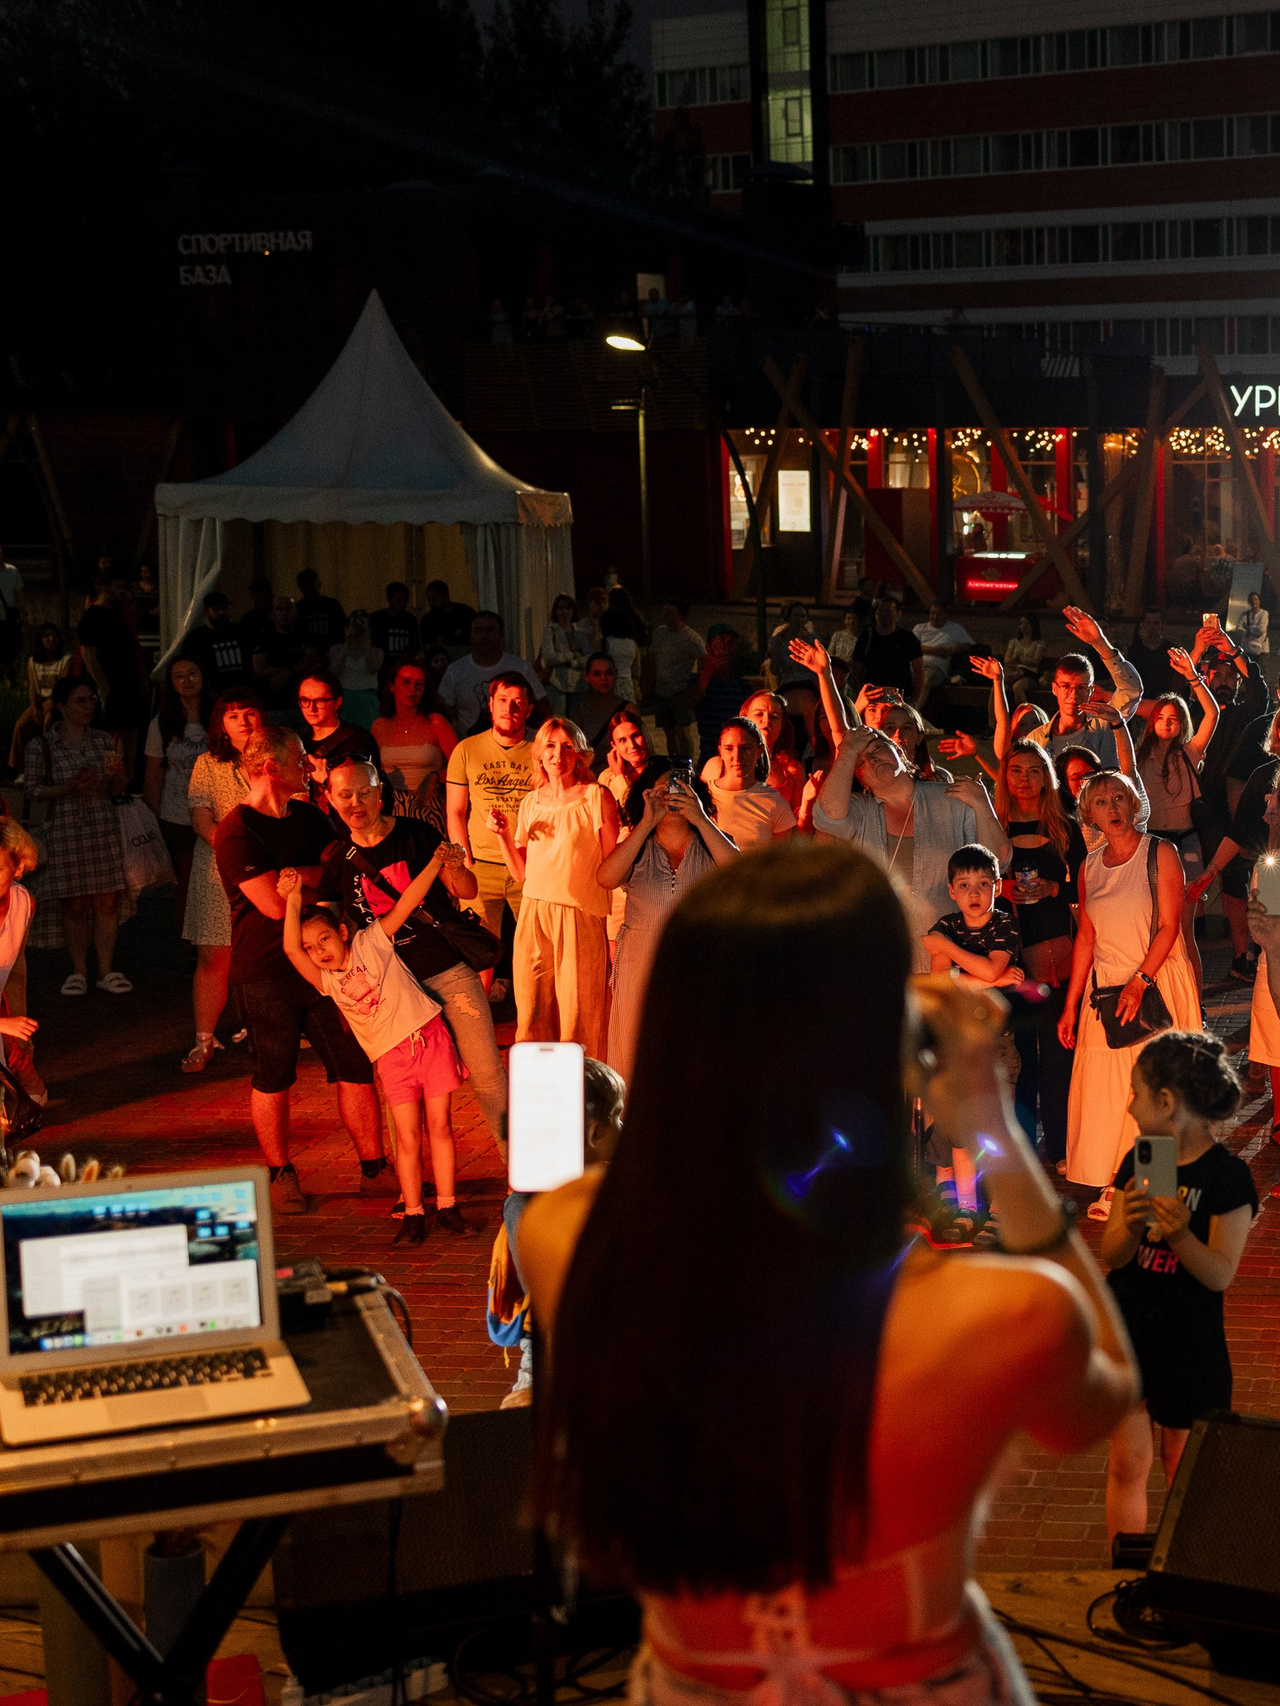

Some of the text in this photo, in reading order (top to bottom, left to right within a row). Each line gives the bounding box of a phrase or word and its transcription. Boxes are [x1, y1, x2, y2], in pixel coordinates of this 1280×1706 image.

[178, 230, 313, 254] СПОРТИВНАЯ
[179, 265, 232, 285] БАЗА
[483, 760, 529, 772] EAST BAY
[475, 772, 533, 788] Los Angel
